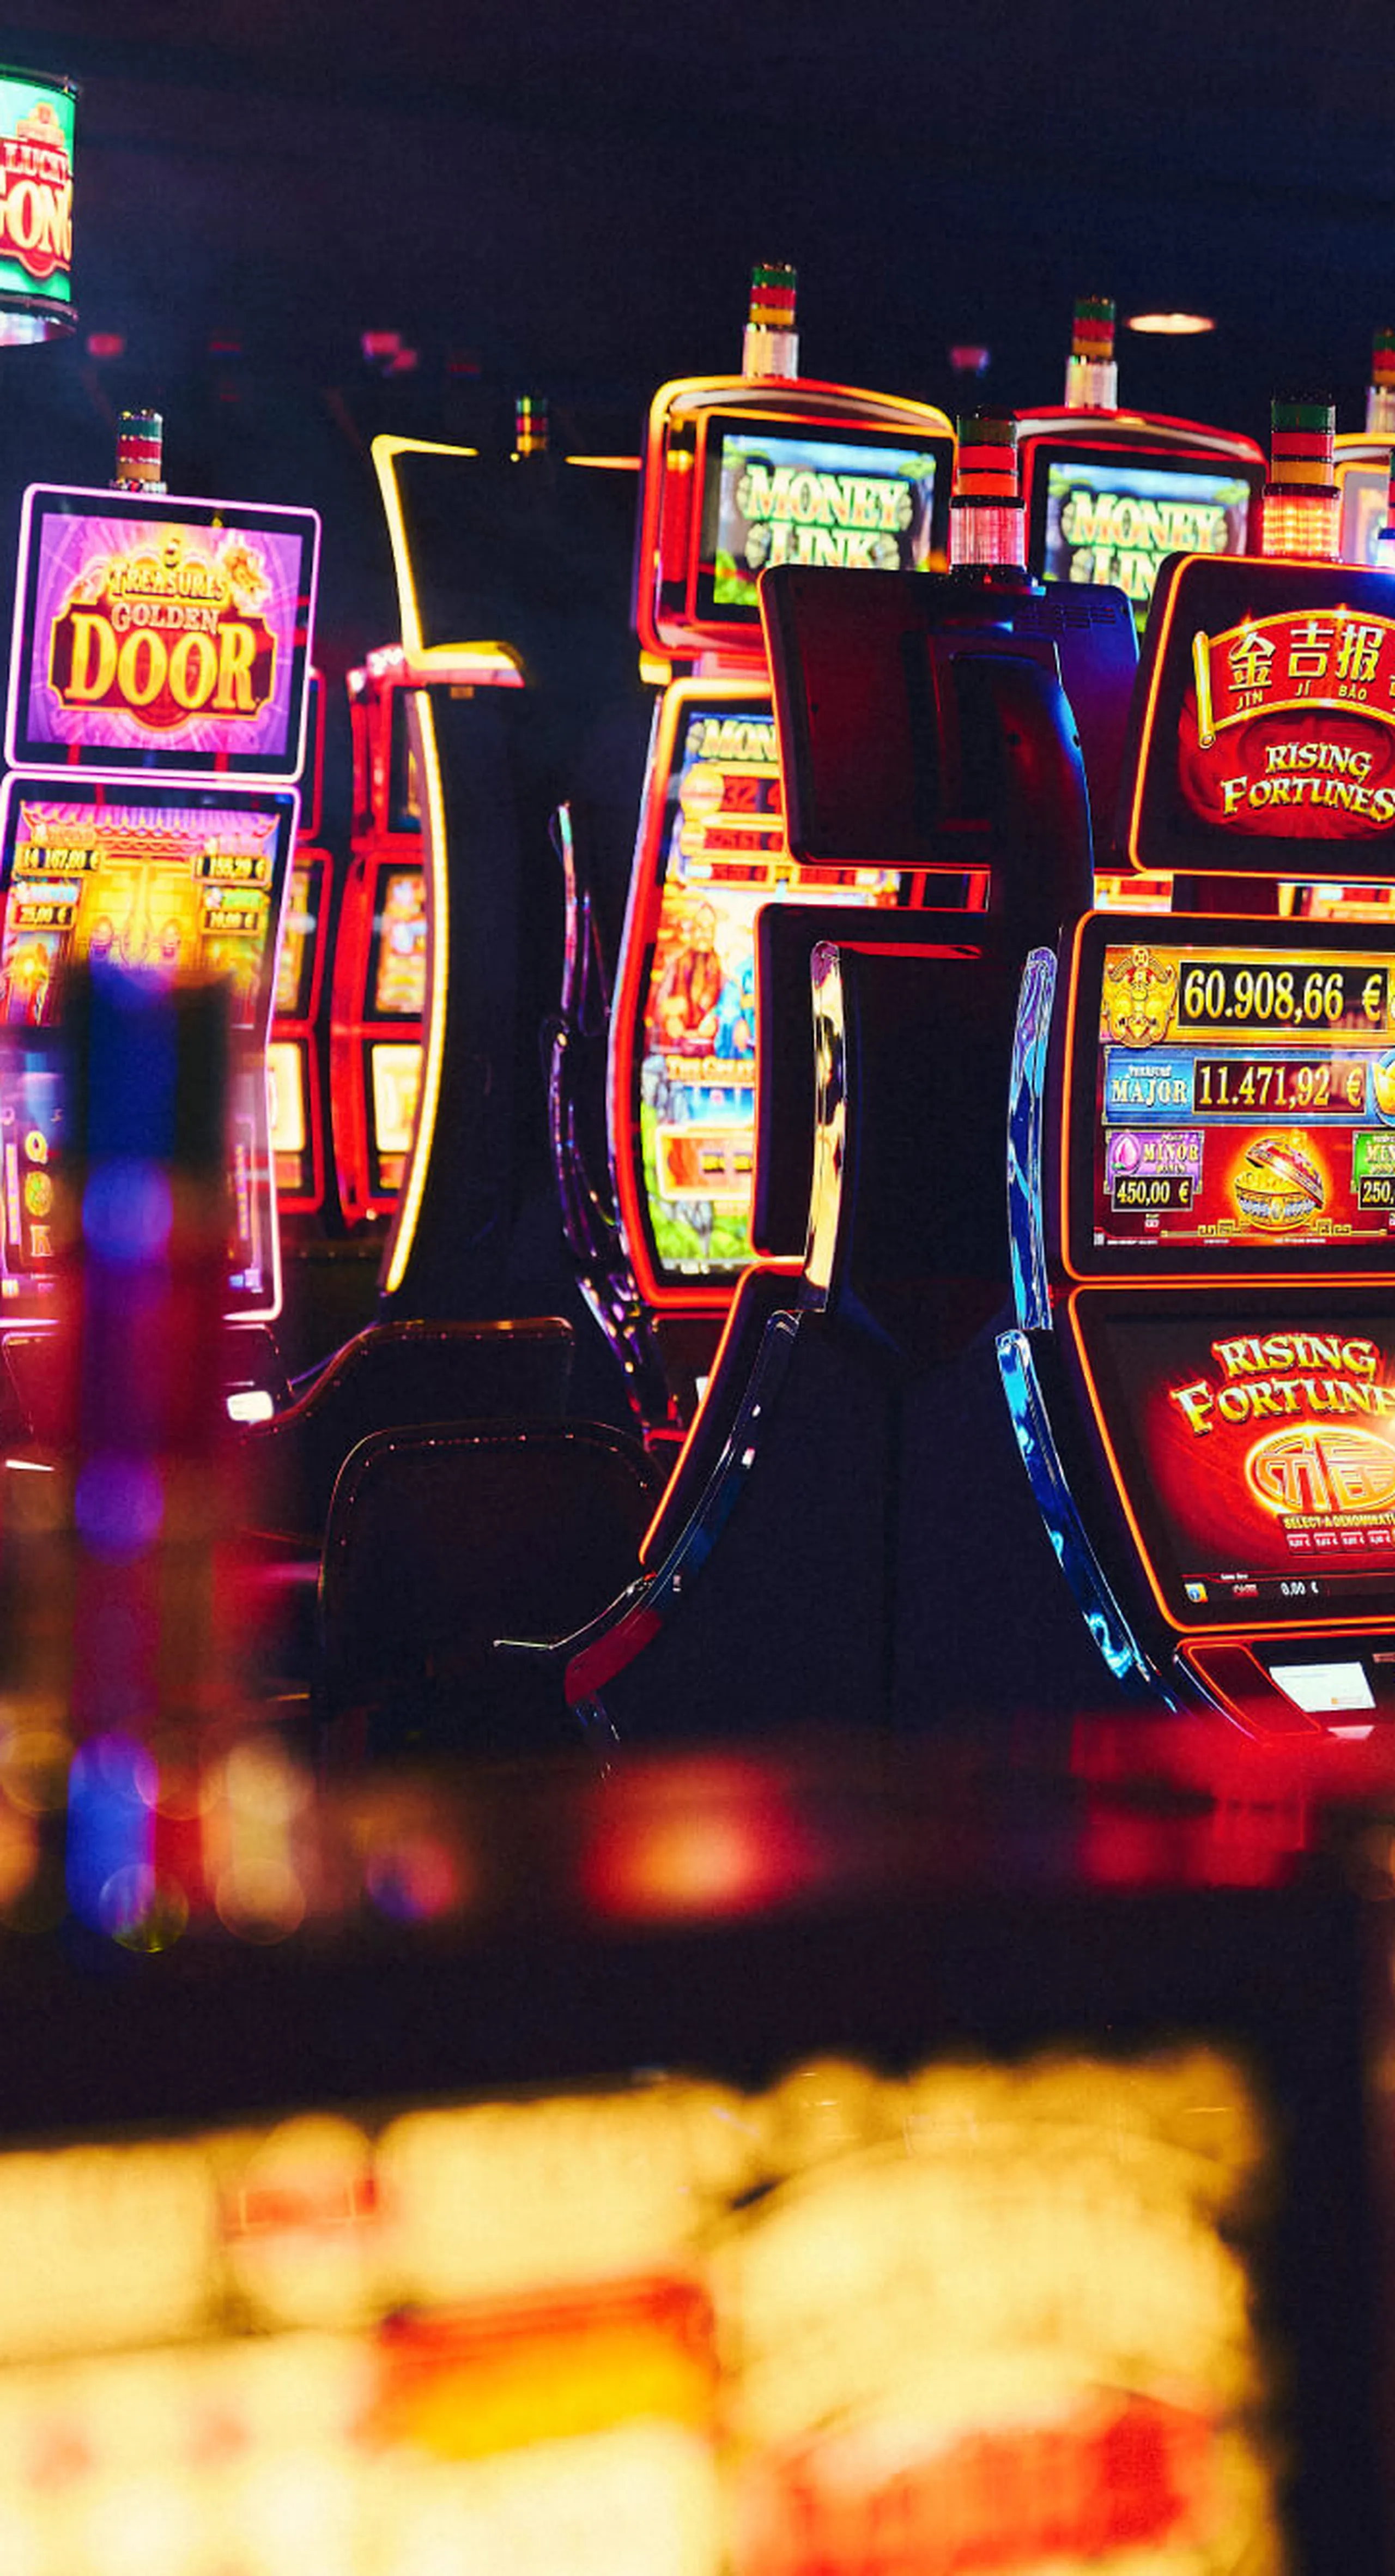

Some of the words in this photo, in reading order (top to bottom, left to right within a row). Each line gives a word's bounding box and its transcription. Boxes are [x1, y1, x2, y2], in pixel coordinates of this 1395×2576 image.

[744, 464, 909, 532] MONEY
[1069, 490, 1224, 552] MONEY
[110, 567, 226, 598] TREASURES
[111, 602, 220, 634] GOLDEN
[64, 613, 256, 710] DOOR
[1265, 742, 1373, 783] RISING
[1221, 775, 1395, 823] FORTUNES
[1184, 969, 1343, 1025] 60.908,66
[1362, 973, 1382, 1021] €
[1111, 1079, 1188, 1107] MAJOR
[1199, 1066, 1330, 1110] 11.471,92
[1346, 1067, 1362, 1108] €
[1144, 1144, 1199, 1162] MINOR
[1117, 1180, 1170, 1206] 450,00
[1178, 1181, 1190, 1204] €
[1214, 1335, 1377, 1382] RISING
